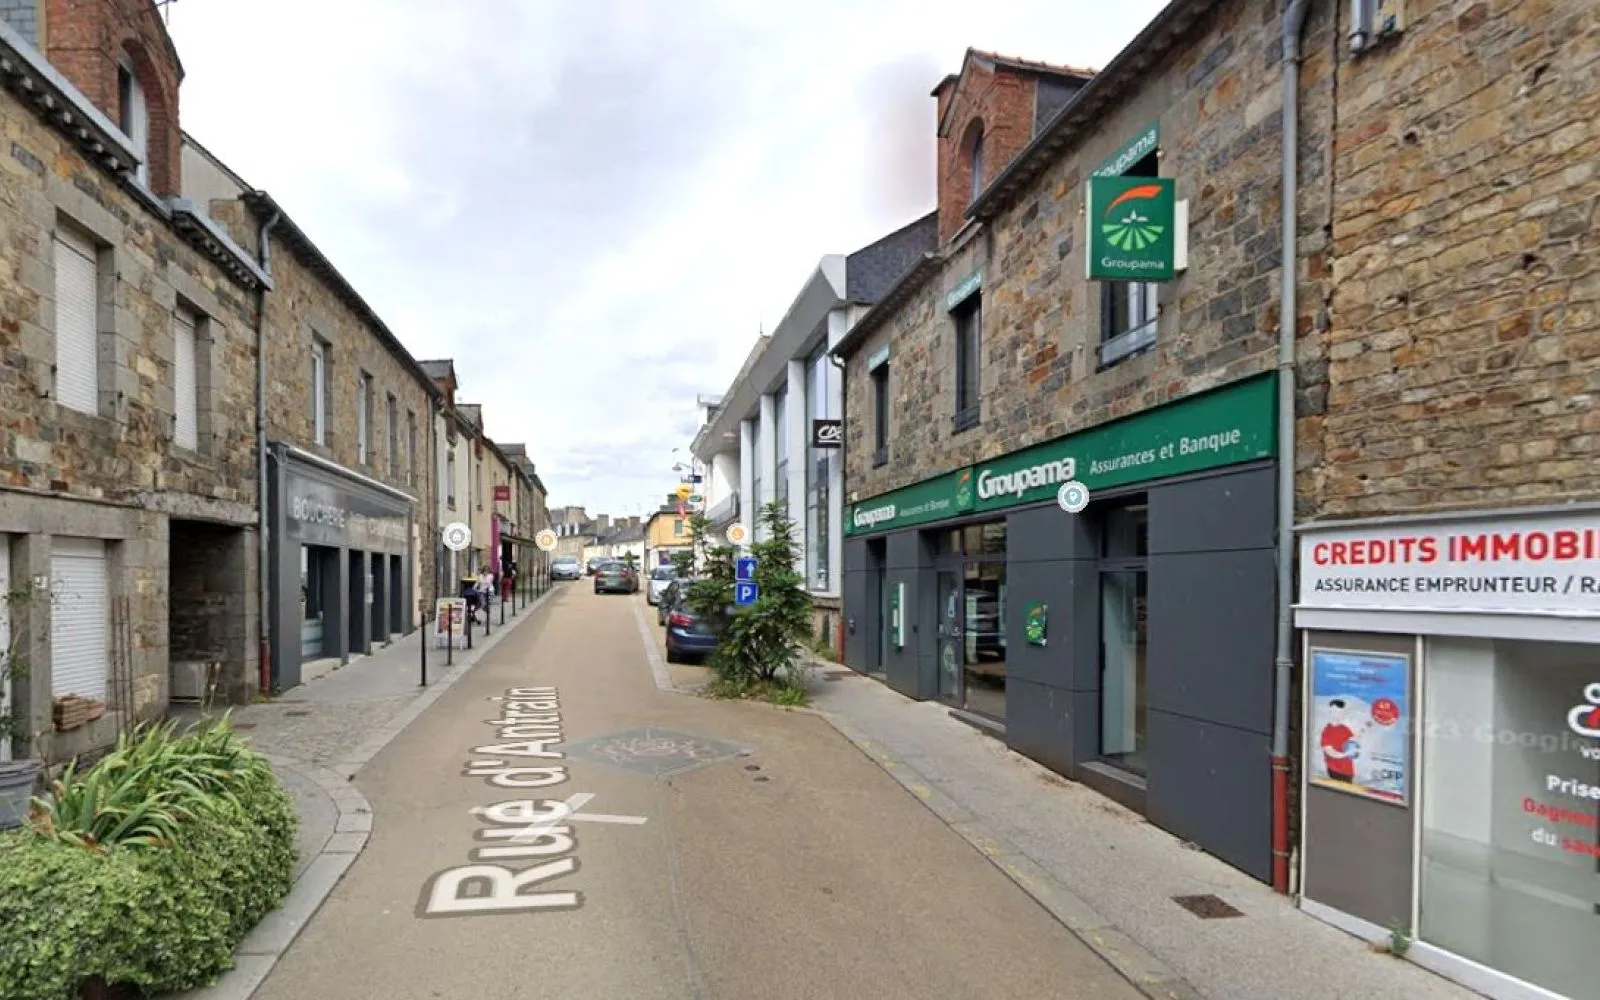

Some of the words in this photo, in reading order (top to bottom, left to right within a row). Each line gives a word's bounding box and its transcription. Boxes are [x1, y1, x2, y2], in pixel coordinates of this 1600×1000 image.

[1101, 255, 1165, 271] Groupama
[978, 456, 1076, 500] Groupama
[1089, 447, 1156, 476] Assurances
[1160, 442, 1175, 460] et
[1179, 428, 1241, 456] Banque
[853, 504, 896, 528] Groupama
[1313, 537, 1438, 565] CREDITS
[1448, 529, 1595, 562] IMMOBI
[741, 586, 753, 601] P
[1314, 577, 1410, 592] ASSURANCE
[1415, 576, 1557, 593] EMPRUNTEUR
[1580, 576, 1600, 594] R
[1531, 827, 1557, 847] du
